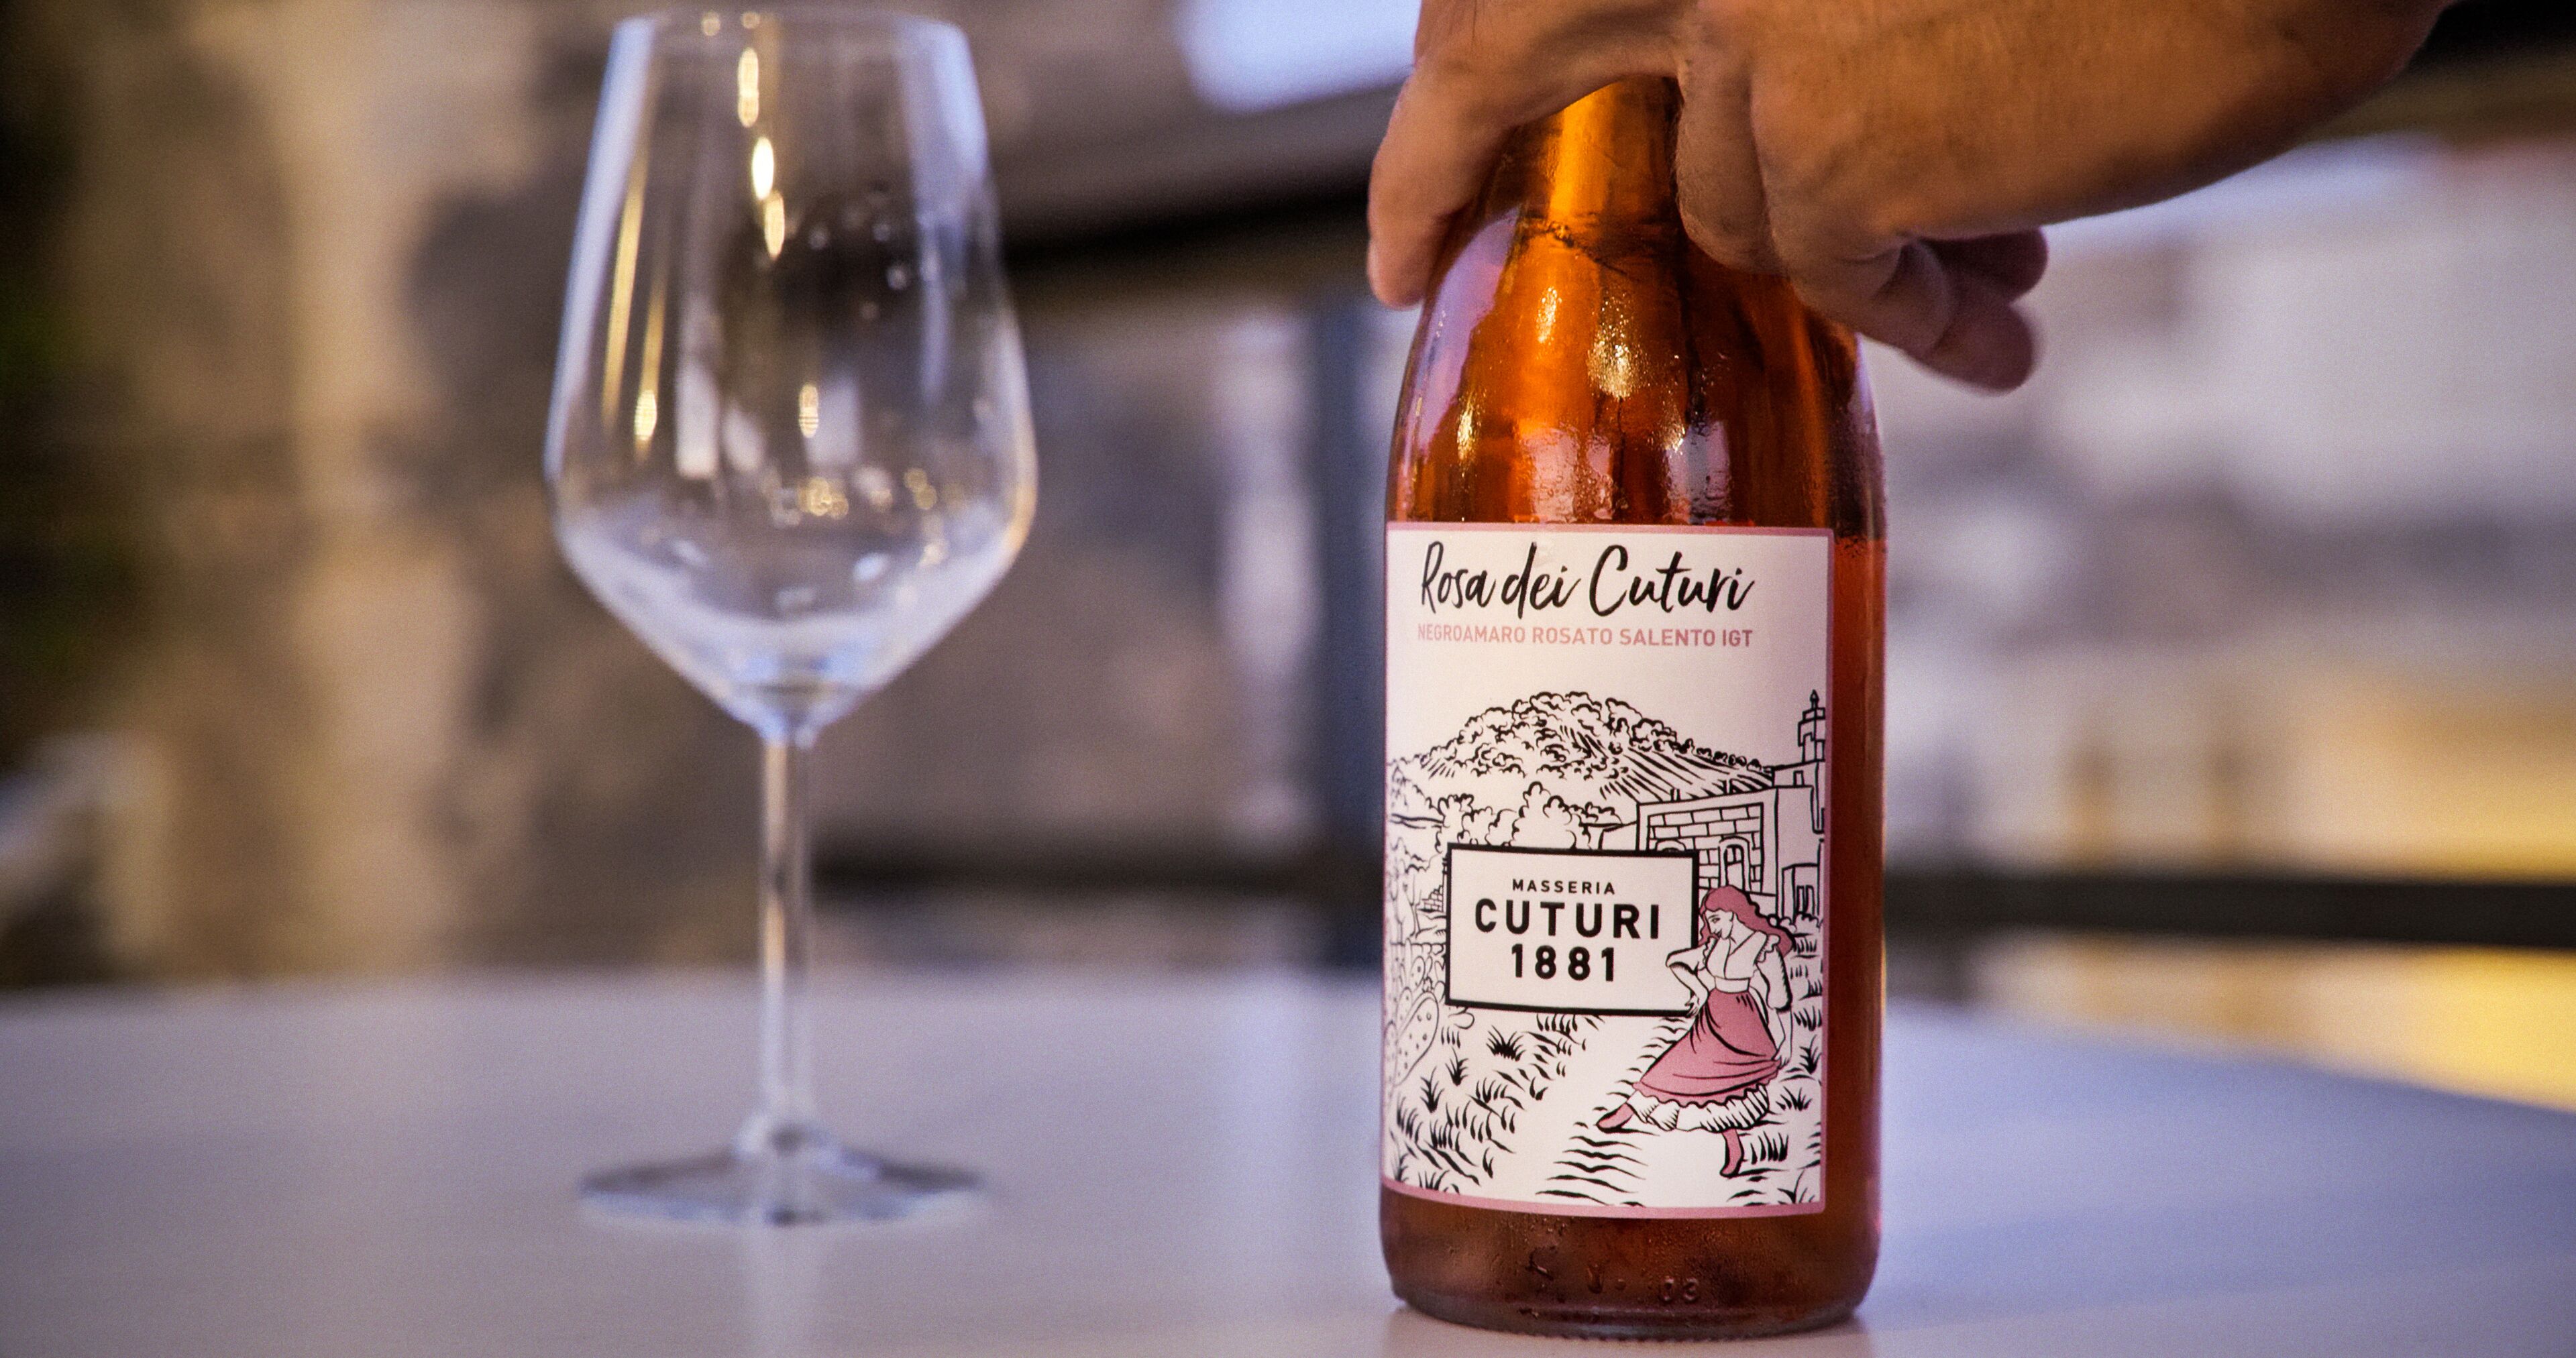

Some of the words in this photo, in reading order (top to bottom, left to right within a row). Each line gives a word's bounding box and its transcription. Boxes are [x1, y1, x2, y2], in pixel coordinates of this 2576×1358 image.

[1421, 541, 1496, 614] Rosa
[1501, 542, 1581, 619] dei
[1589, 544, 1756, 617] Cuturi
[1417, 622, 1525, 643] NEGROAMARO
[1532, 626, 1613, 644] ROSATO
[1619, 628, 1716, 647] SALENTO
[1722, 628, 1753, 647] IGT
[1512, 878, 1615, 895] MASSERIA
[1475, 898, 1660, 940] CUTURI
[1511, 943, 1615, 982] 1881
